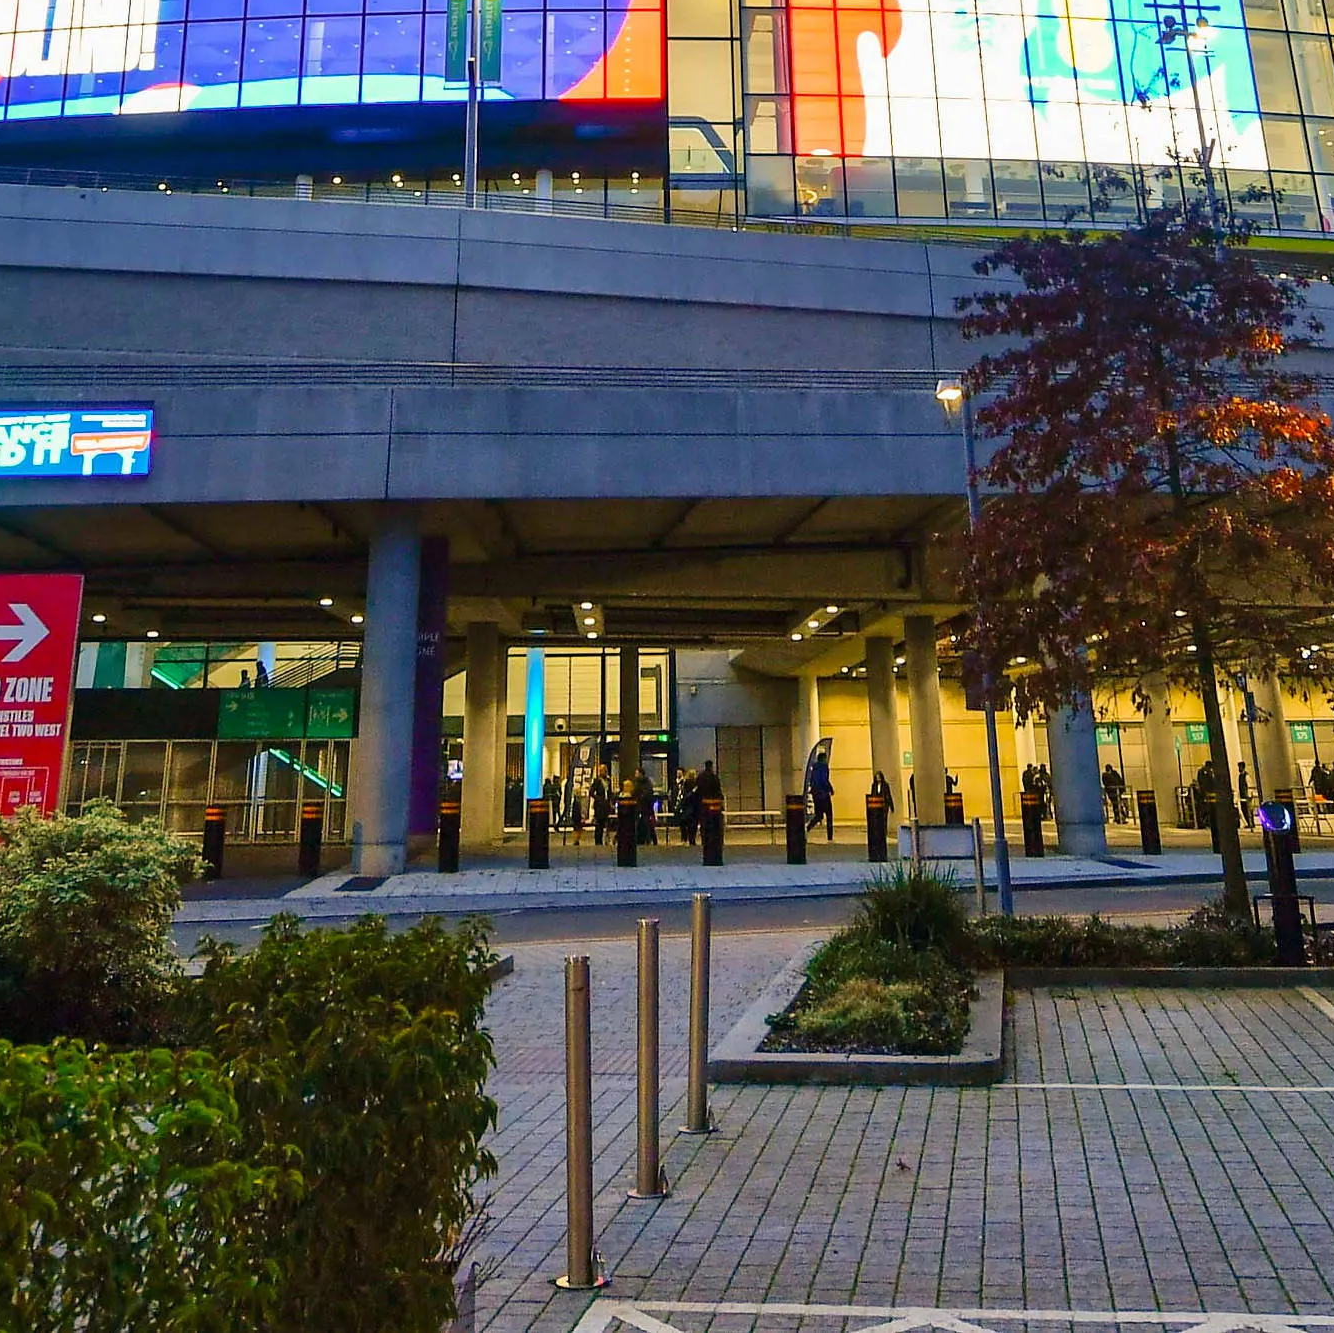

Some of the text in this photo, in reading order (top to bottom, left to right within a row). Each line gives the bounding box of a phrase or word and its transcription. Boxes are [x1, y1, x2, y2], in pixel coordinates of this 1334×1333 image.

[3, 676, 54, 703] ZONE
[12, 723, 33, 737] TWO
[34, 723, 61, 737] WEST
